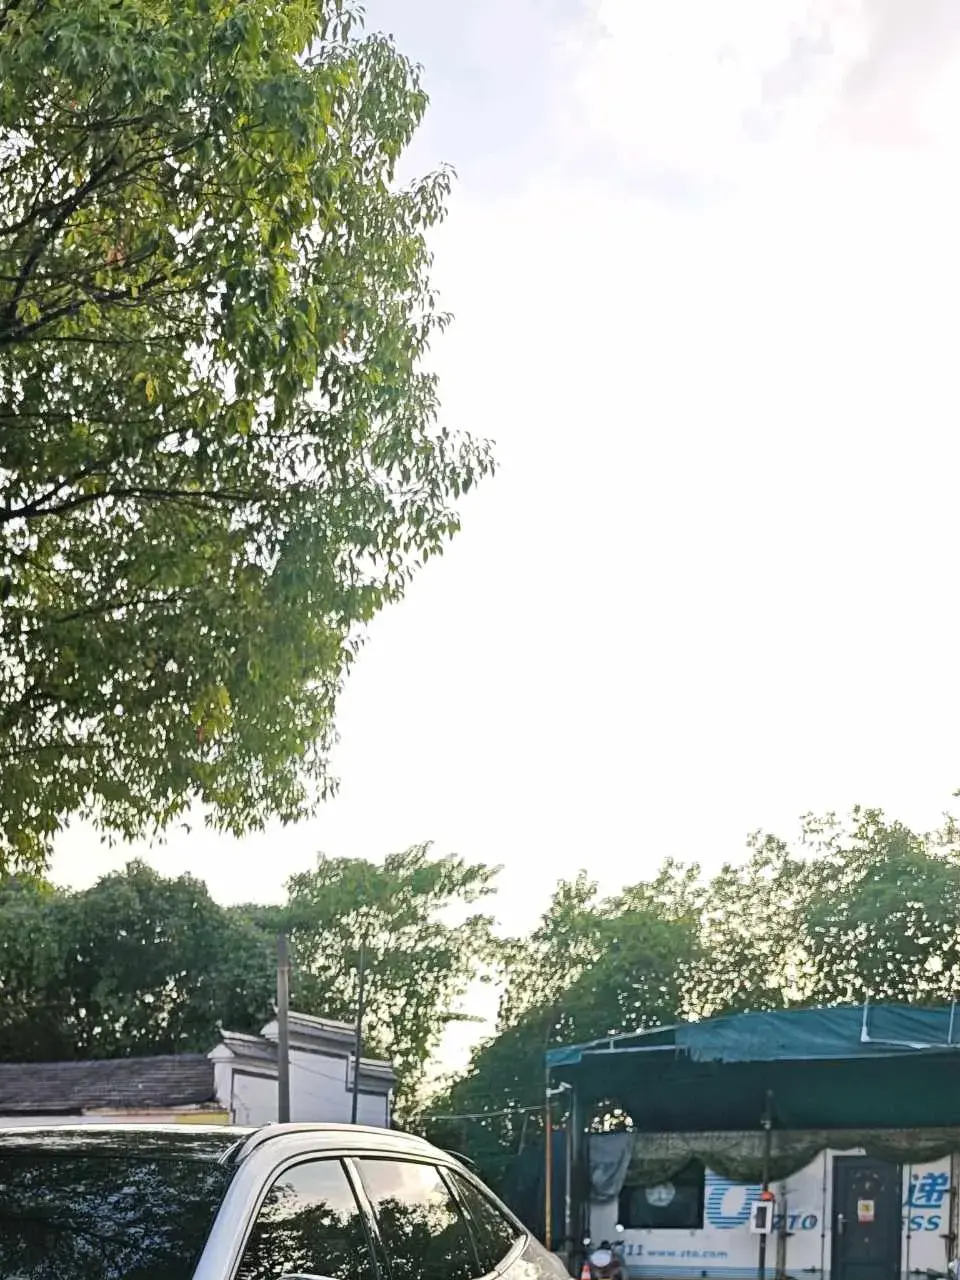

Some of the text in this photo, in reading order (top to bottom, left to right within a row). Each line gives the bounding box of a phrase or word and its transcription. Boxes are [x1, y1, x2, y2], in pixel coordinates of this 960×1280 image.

[902, 1172, 949, 1209] 递
[772, 1214, 942, 1232] ZTO SS
